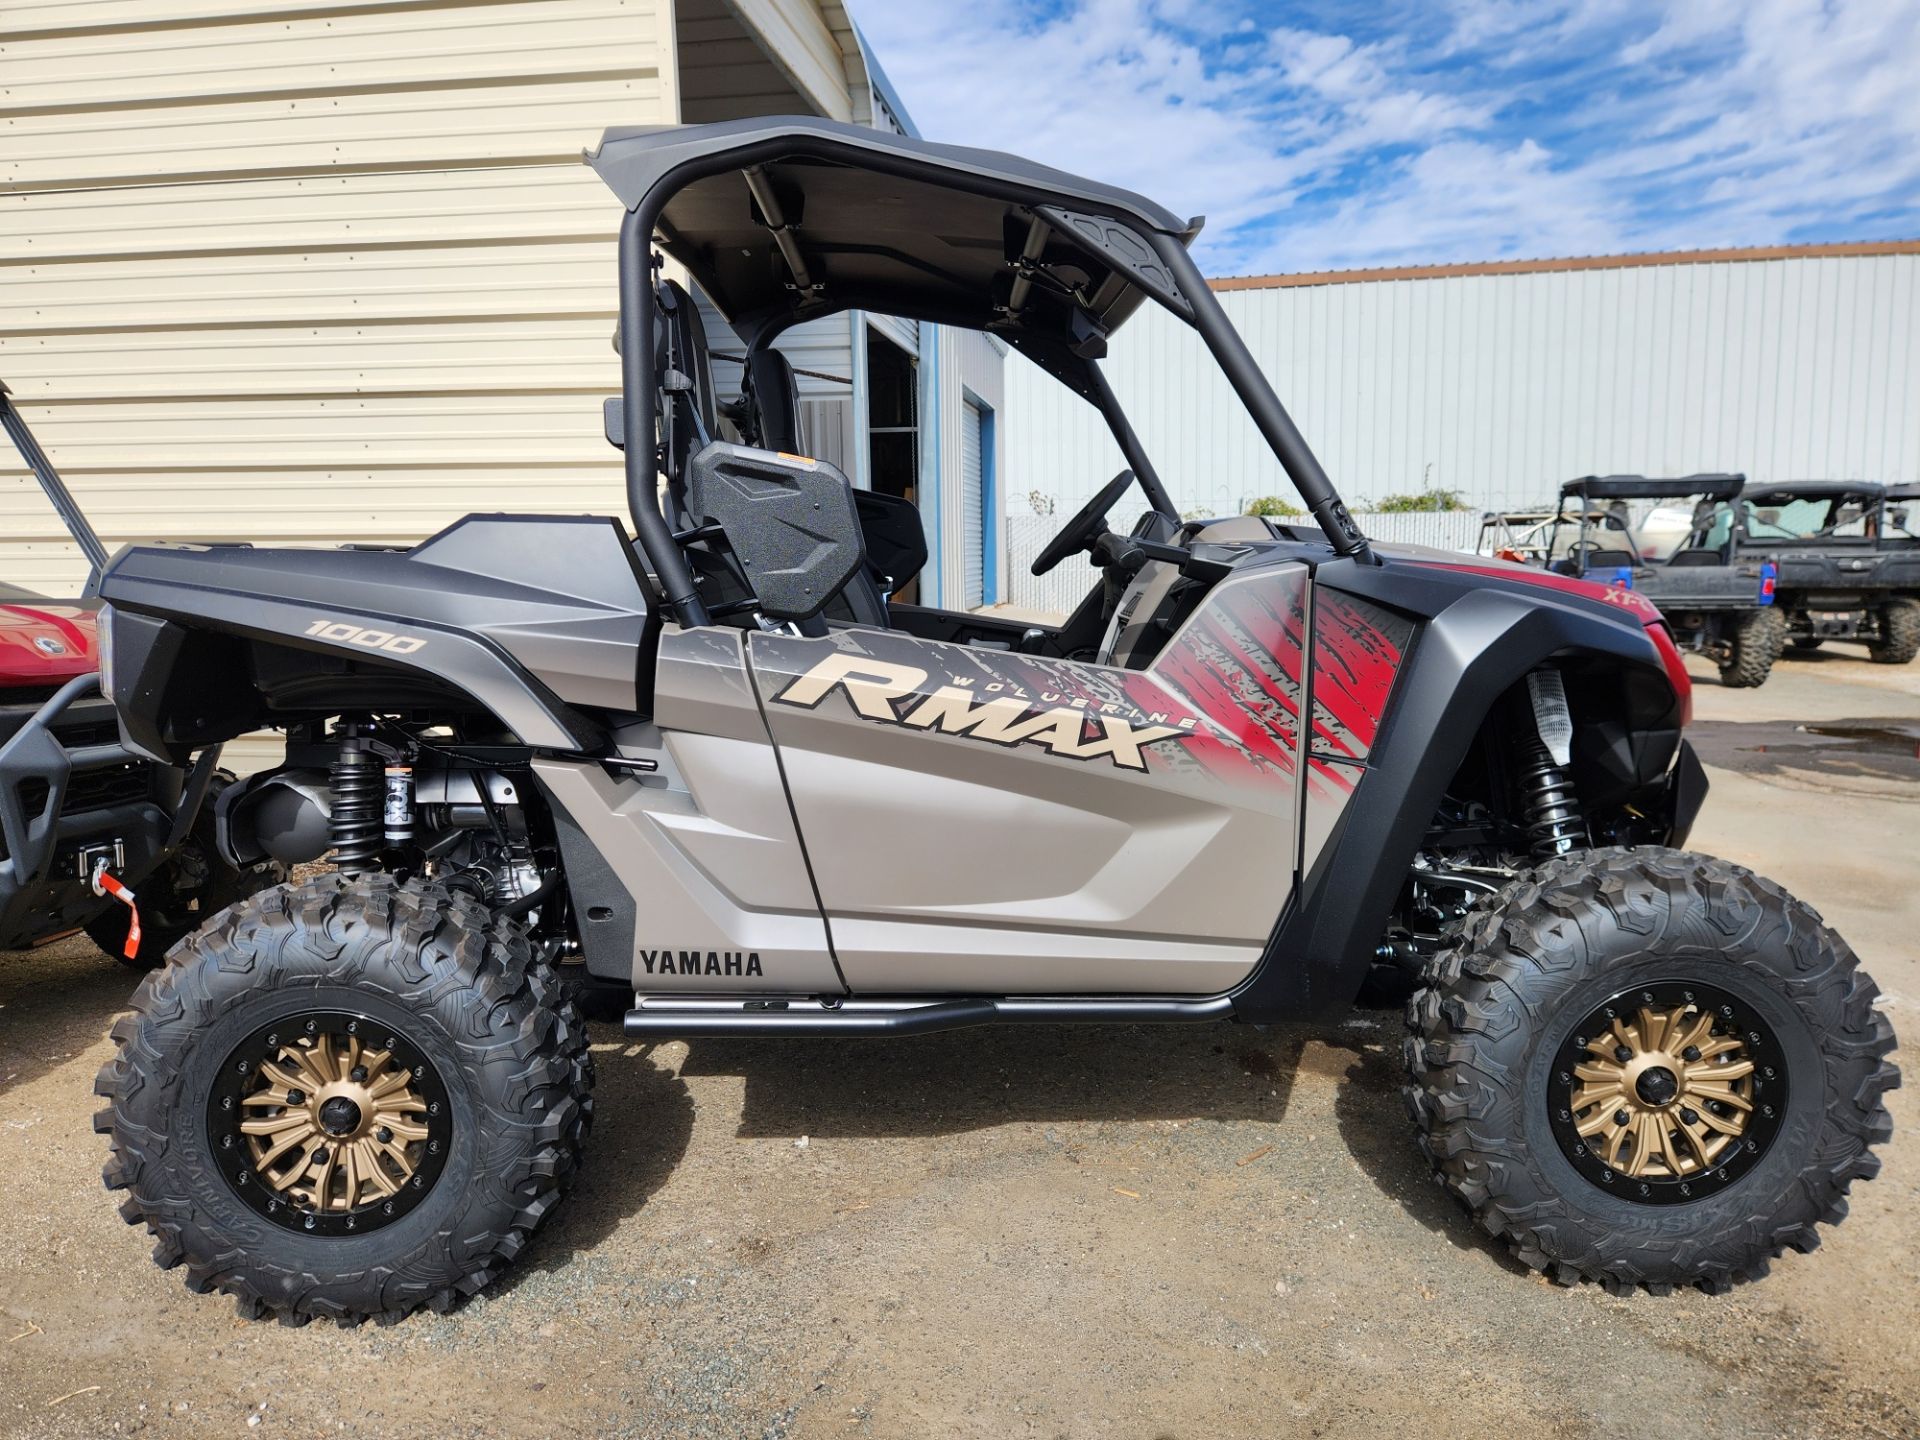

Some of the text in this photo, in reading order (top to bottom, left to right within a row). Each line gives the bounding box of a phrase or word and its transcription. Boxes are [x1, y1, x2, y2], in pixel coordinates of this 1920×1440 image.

[304, 620, 428, 654] 1000
[771, 653, 1197, 773] RMAX
[386, 781, 409, 822] FOX
[640, 950, 763, 976] YAMAHA
